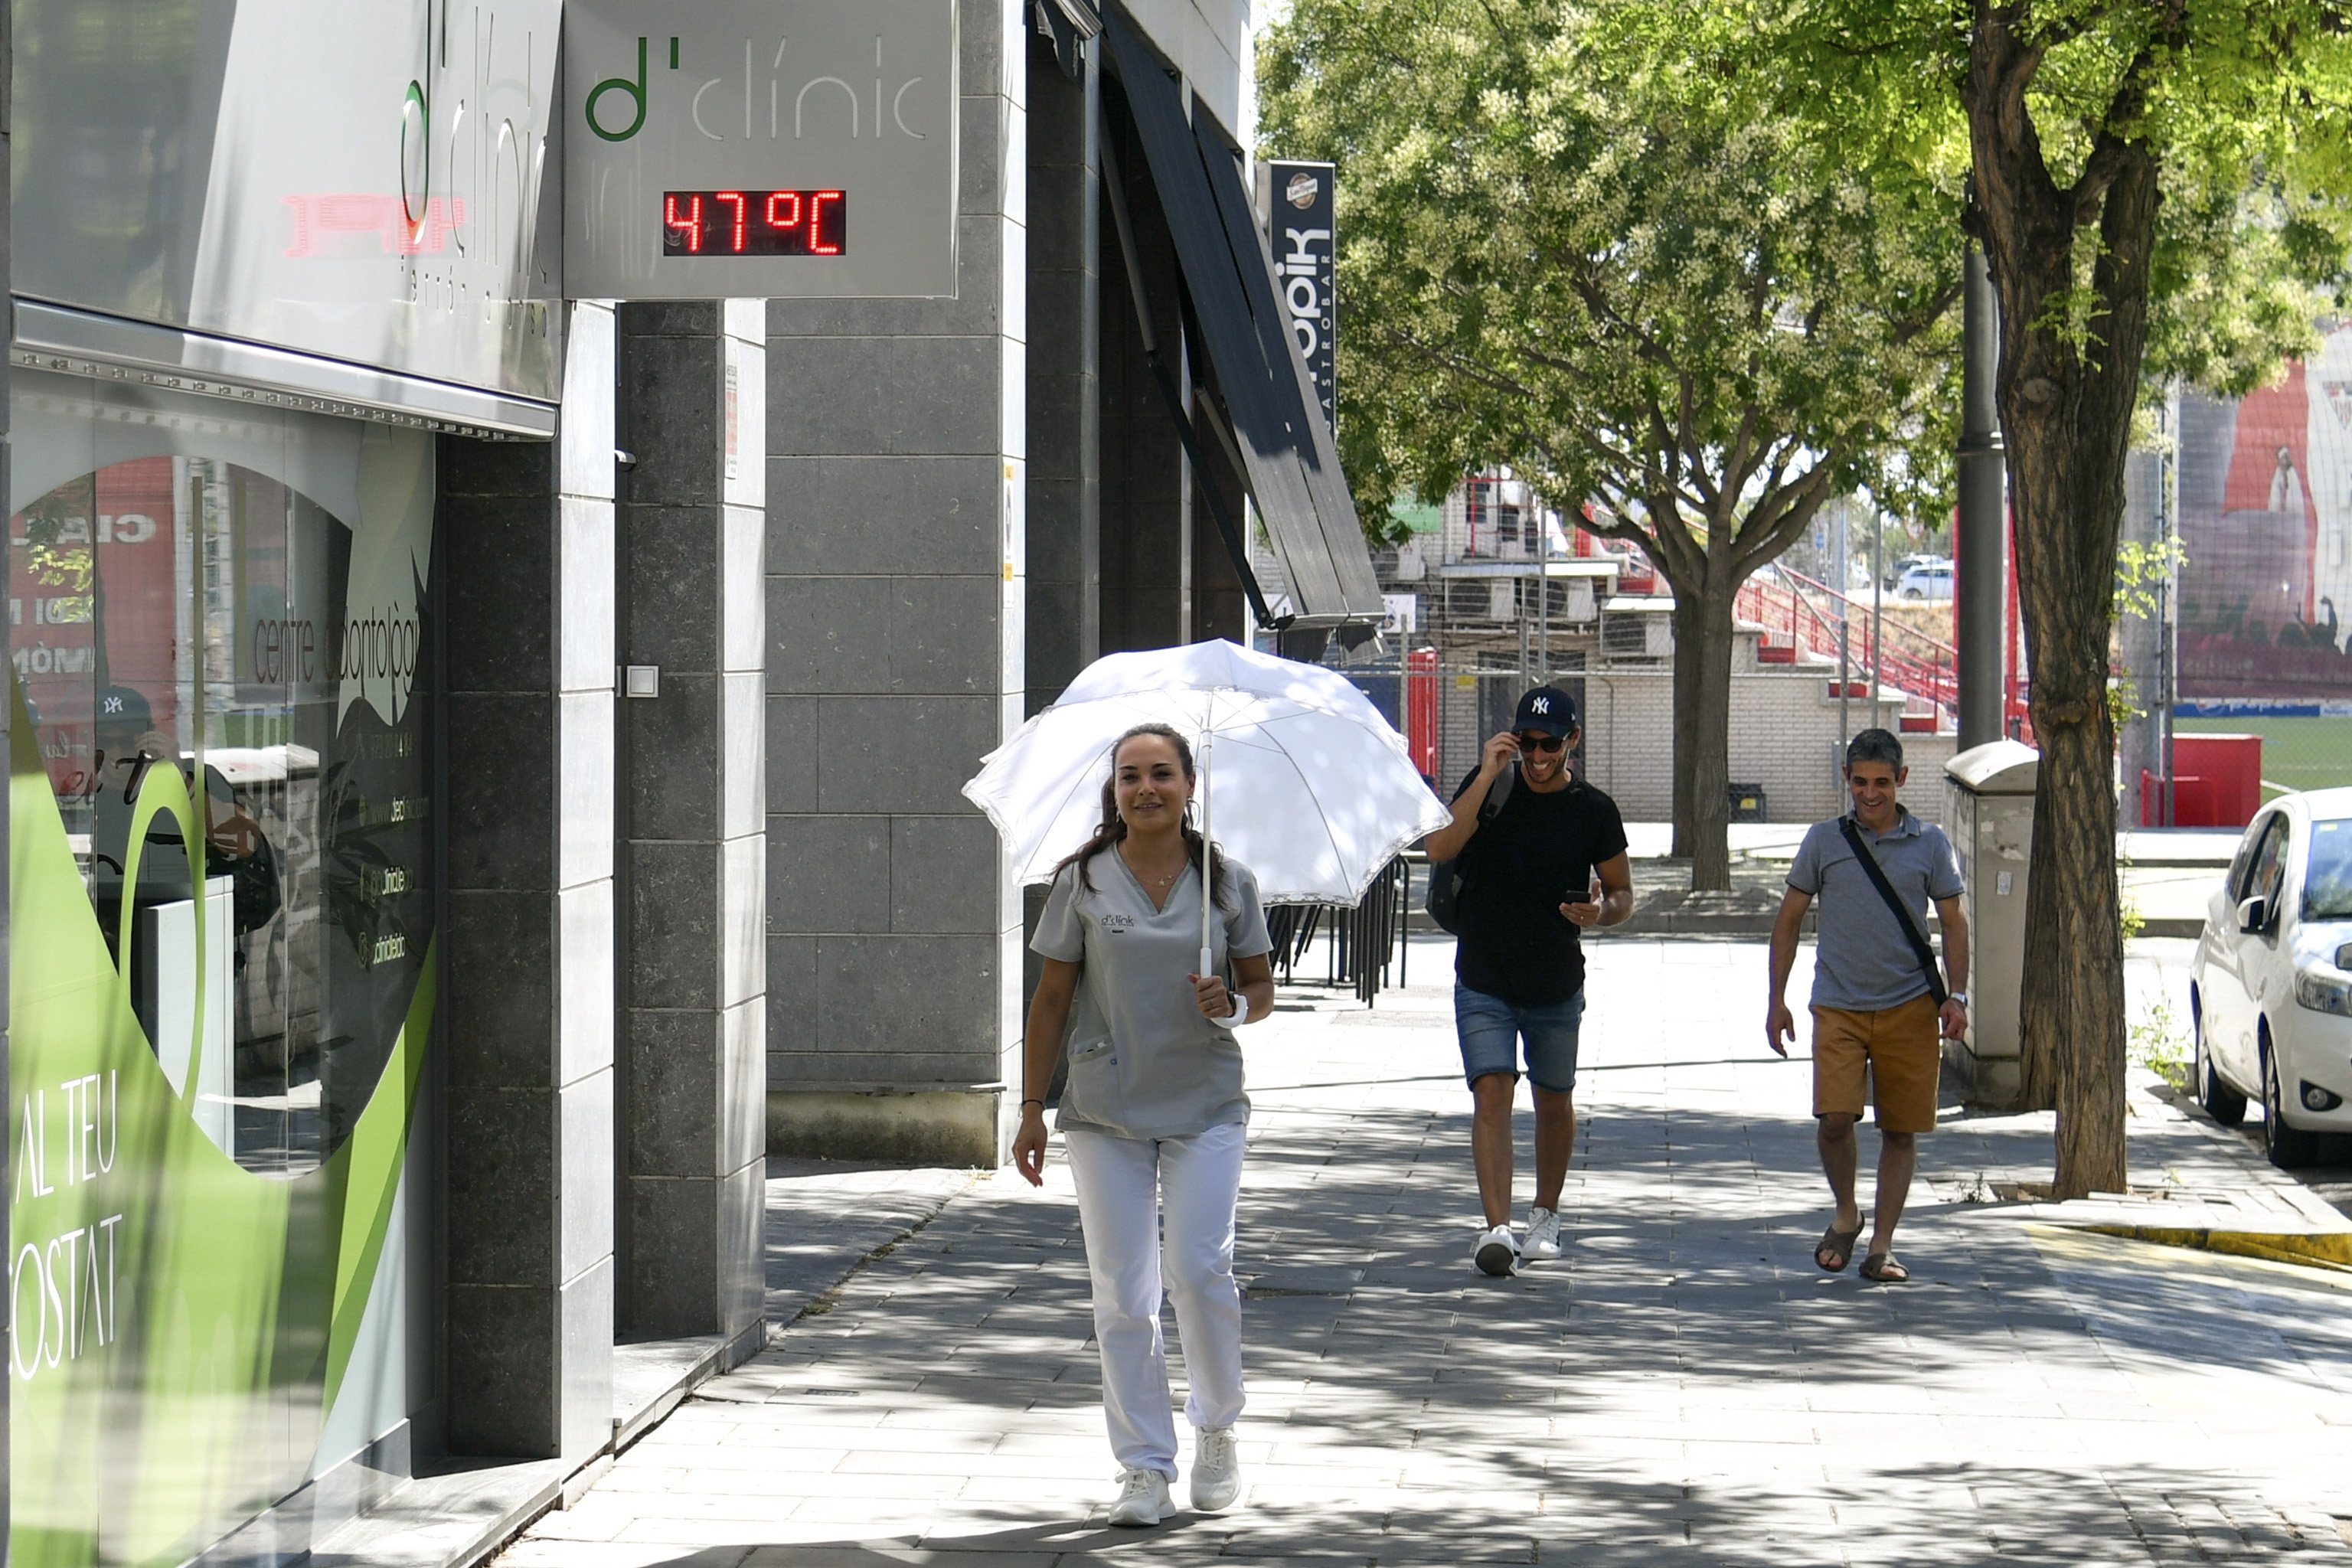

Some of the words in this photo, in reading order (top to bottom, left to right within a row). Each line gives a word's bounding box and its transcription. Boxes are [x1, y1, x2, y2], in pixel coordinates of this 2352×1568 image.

[585, 35, 926, 142] d'clínic
[255, 606, 315, 684] centre
[1531, 696, 1550, 714] NY
[16, 1089, 54, 1204] AL
[60, 1069, 116, 1187] TEU
[8, 1214, 122, 1381] OSTAT
